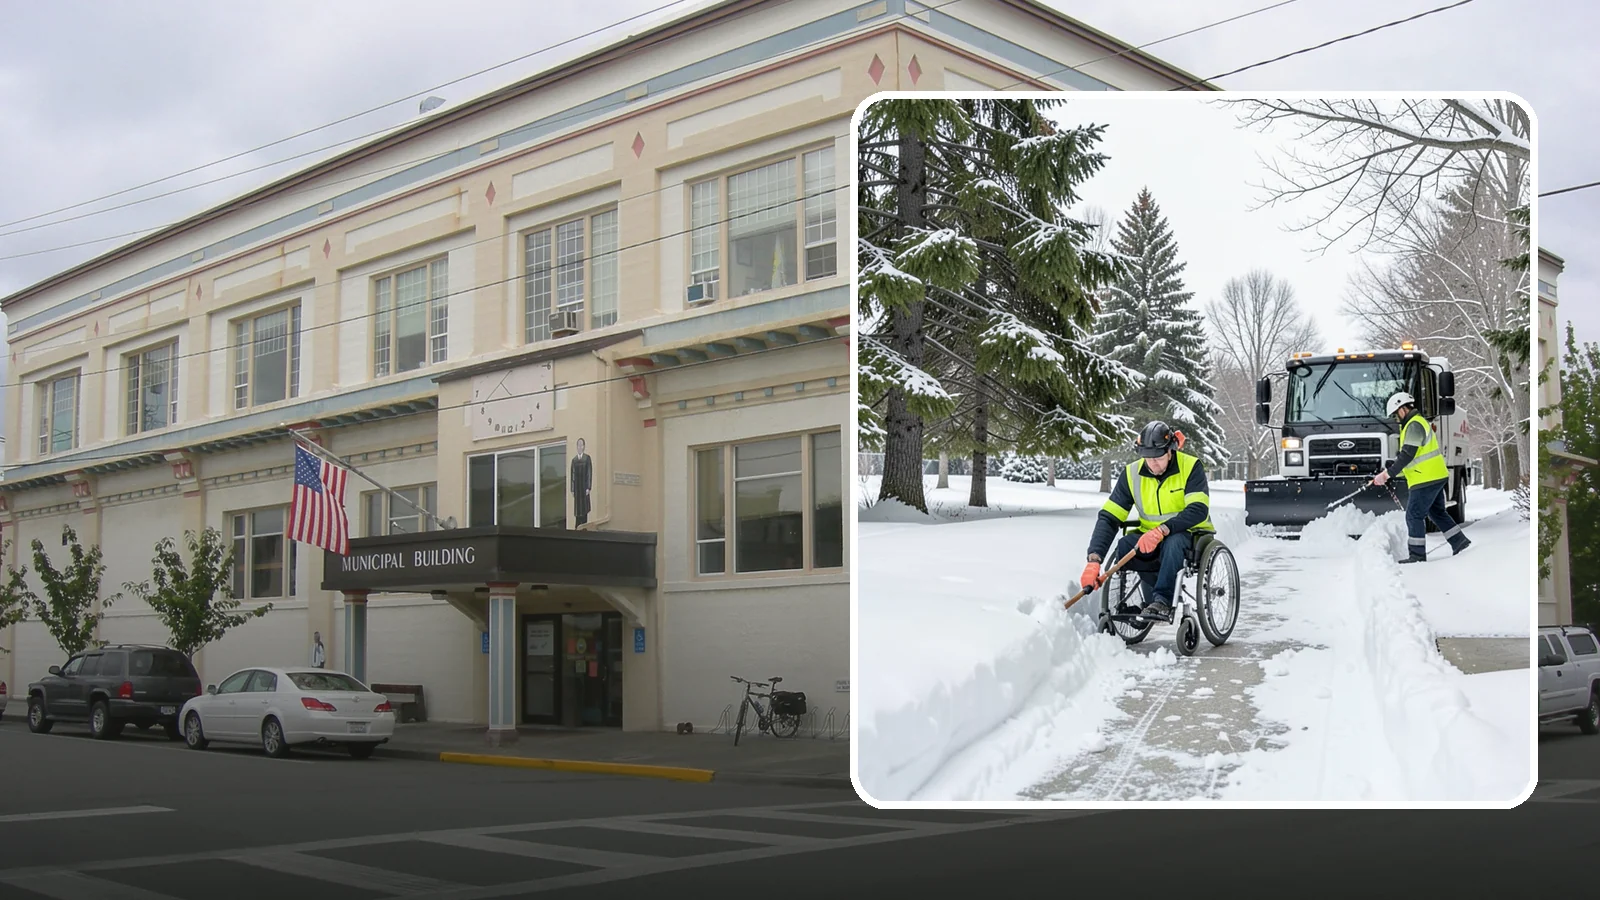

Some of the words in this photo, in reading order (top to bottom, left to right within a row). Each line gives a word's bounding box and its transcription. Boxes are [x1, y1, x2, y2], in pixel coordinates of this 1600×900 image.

[536, 402, 540, 410] 4
[480, 407, 485, 415] 8
[488, 417, 492, 425] 9
[529, 414, 533, 422] 3
[494, 423, 500, 432] 10
[521, 420, 525, 428] 2
[507, 425, 513, 433] 12
[342, 552, 405, 572] MUNICIPAL
[414, 546, 475, 567] BUILDING
